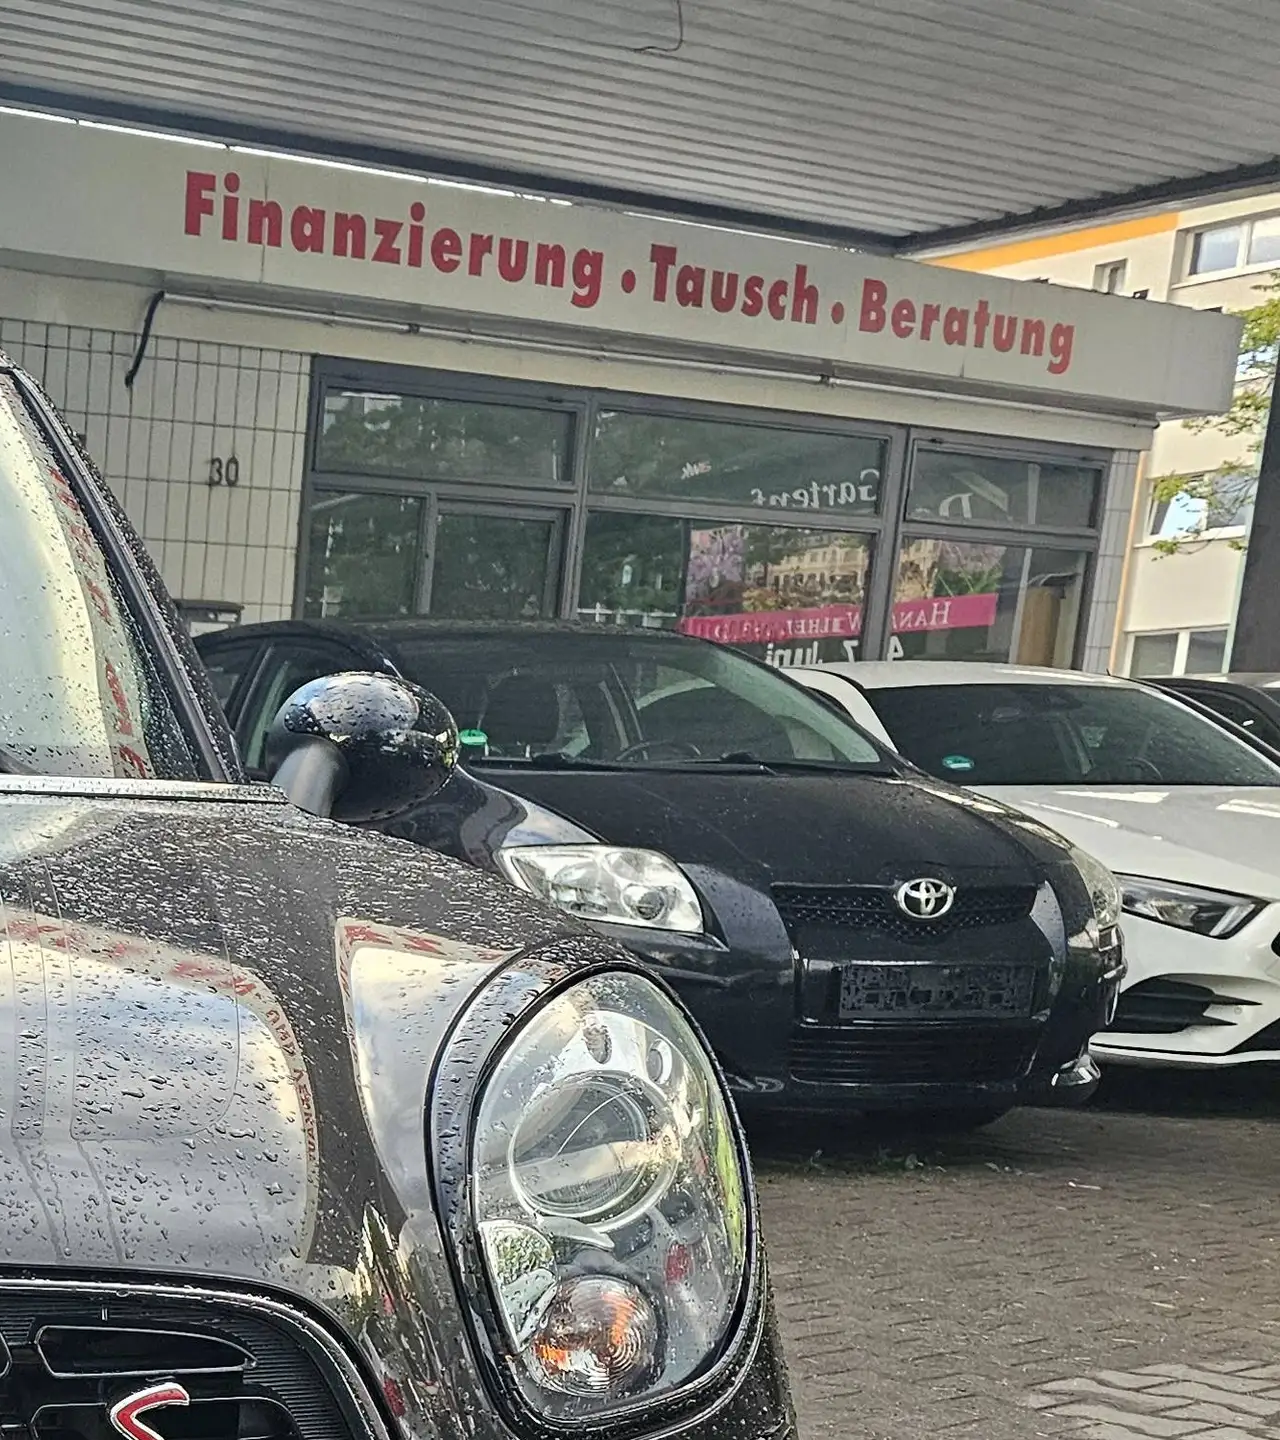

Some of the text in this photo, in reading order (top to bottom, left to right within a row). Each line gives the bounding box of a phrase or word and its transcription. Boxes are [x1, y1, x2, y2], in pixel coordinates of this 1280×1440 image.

[184, 171, 1075, 375] Finanzierung Tausch Beratung
[209, 457, 239, 487] 30
